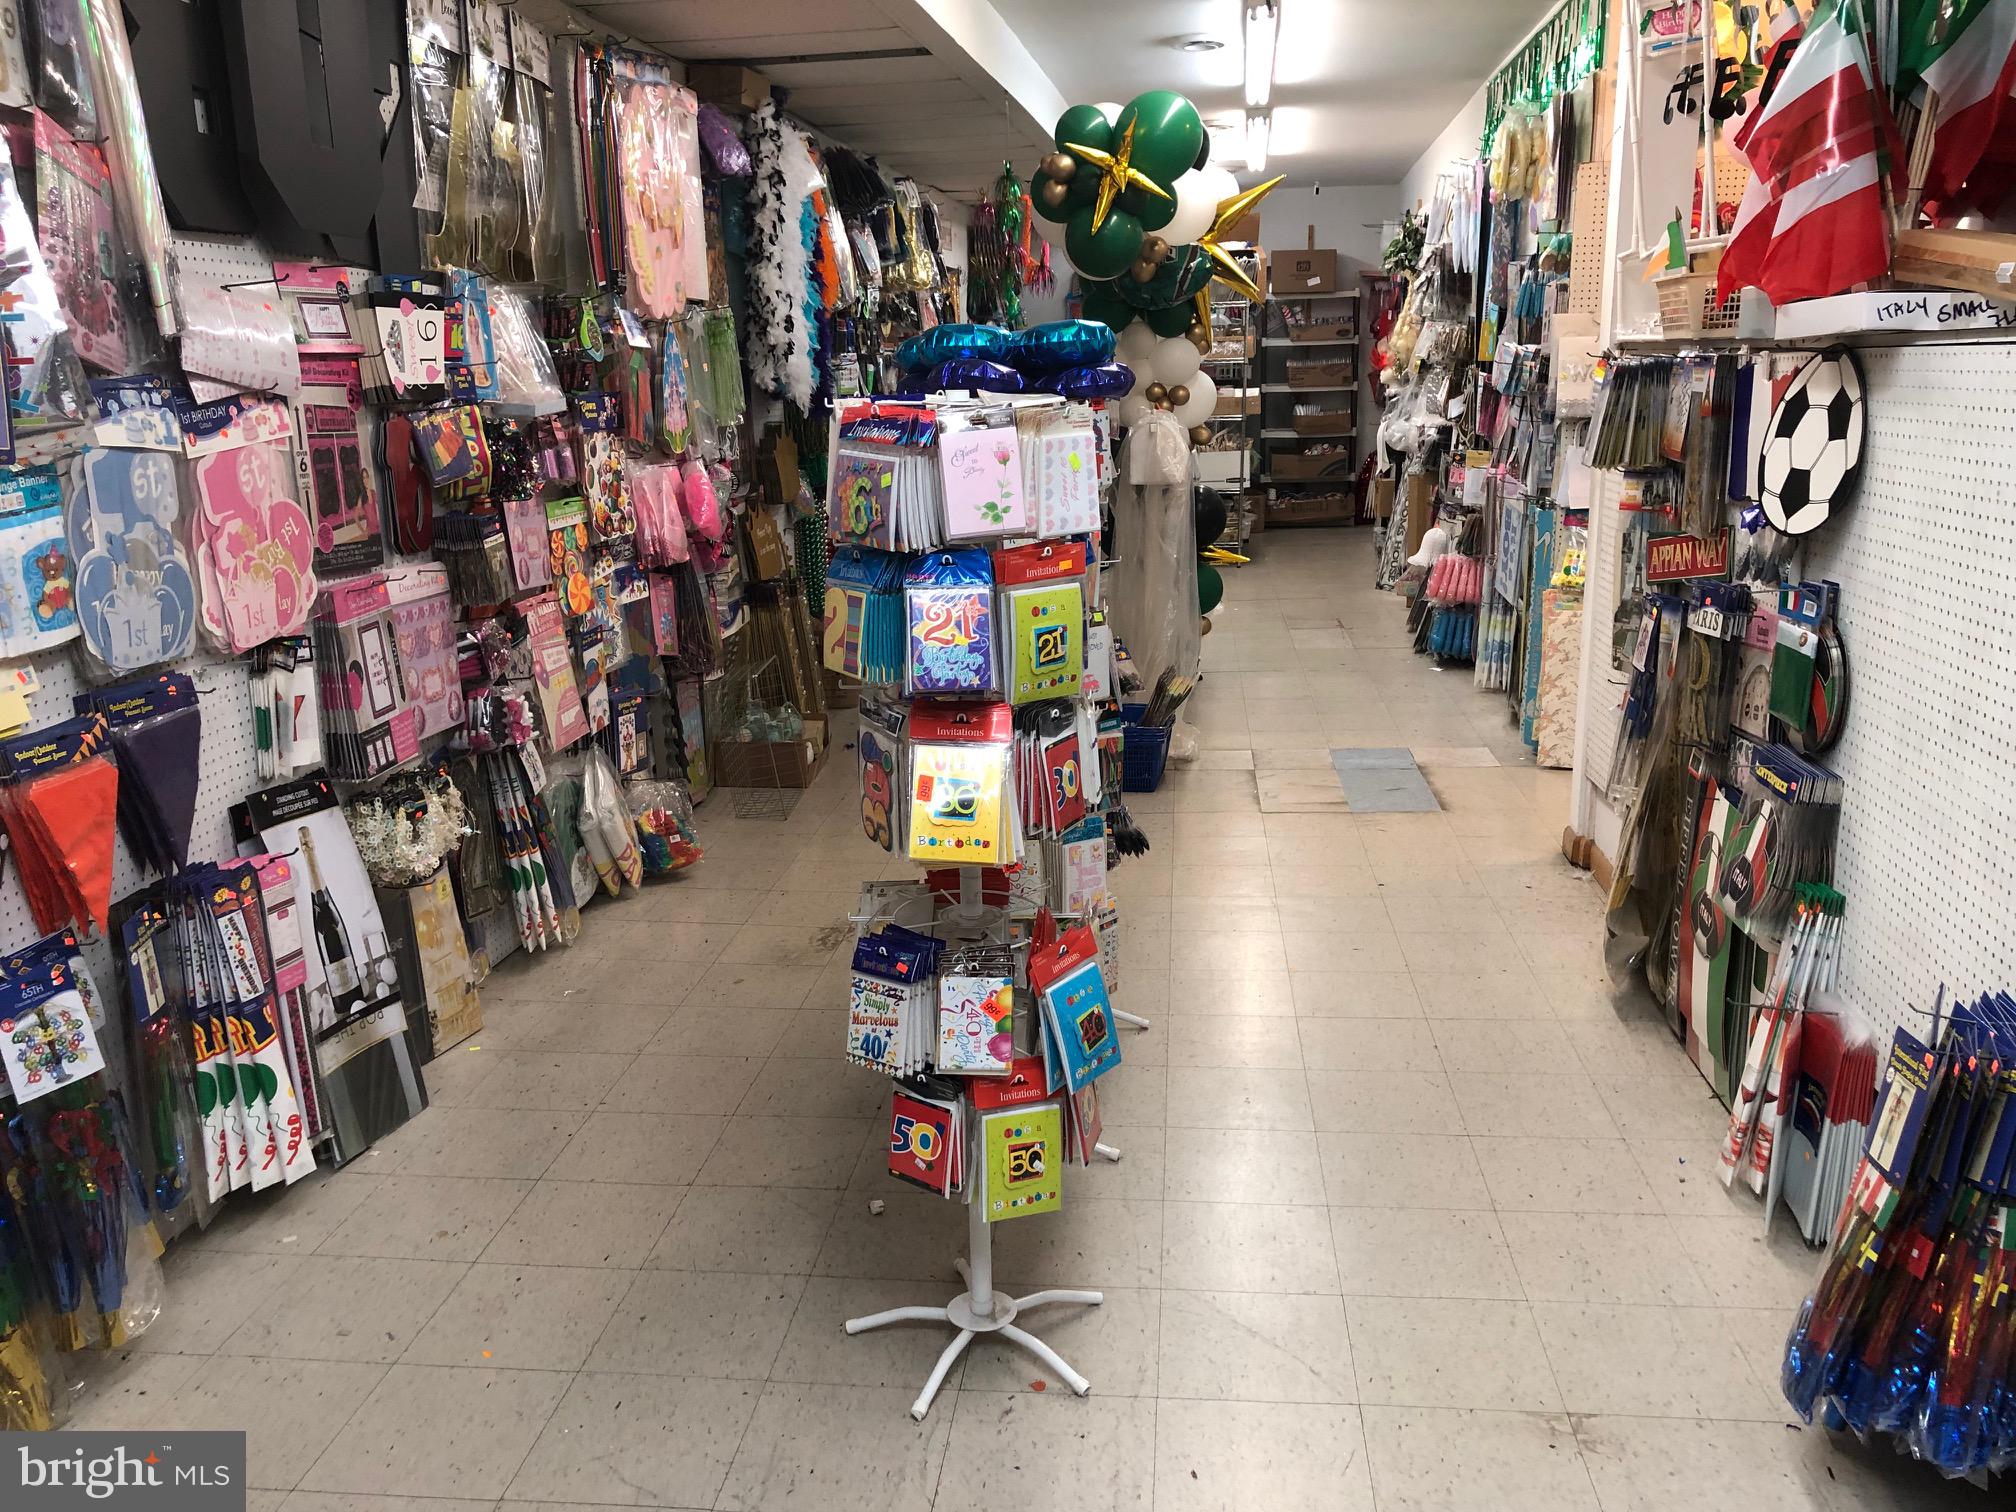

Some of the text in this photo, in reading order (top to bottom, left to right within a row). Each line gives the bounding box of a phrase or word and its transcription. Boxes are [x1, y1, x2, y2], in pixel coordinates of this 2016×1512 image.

[1877, 297, 1929, 321] ITALY
[190, 405, 227, 423] BIRTHDAY
[846, 418, 902, 440] Invitations
[299, 457, 308, 472] 6
[19, 475, 48, 488] Banner
[1648, 537, 1726, 574] APPIAN WAY
[241, 602, 266, 629] 1st
[923, 600, 980, 648] 21
[121, 619, 149, 649] 1st
[936, 727, 985, 737] Invitations
[1732, 867, 1748, 891] ITALY
[1700, 901, 1712, 930] ITALY
[227, 915, 244, 941] HAPPY
[237, 957, 260, 996] BIRTHDAY
[1052, 951, 1081, 974] Invitations
[1666, 906, 1682, 1006] TOWER
[21, 983, 44, 999] 65TH
[863, 993, 890, 1014] Simply
[851, 1011, 899, 1027] Marvelous
[860, 1032, 889, 1060] 40!
[1000, 1088, 1041, 1101] Invitations
[891, 1113, 943, 1161] 50
